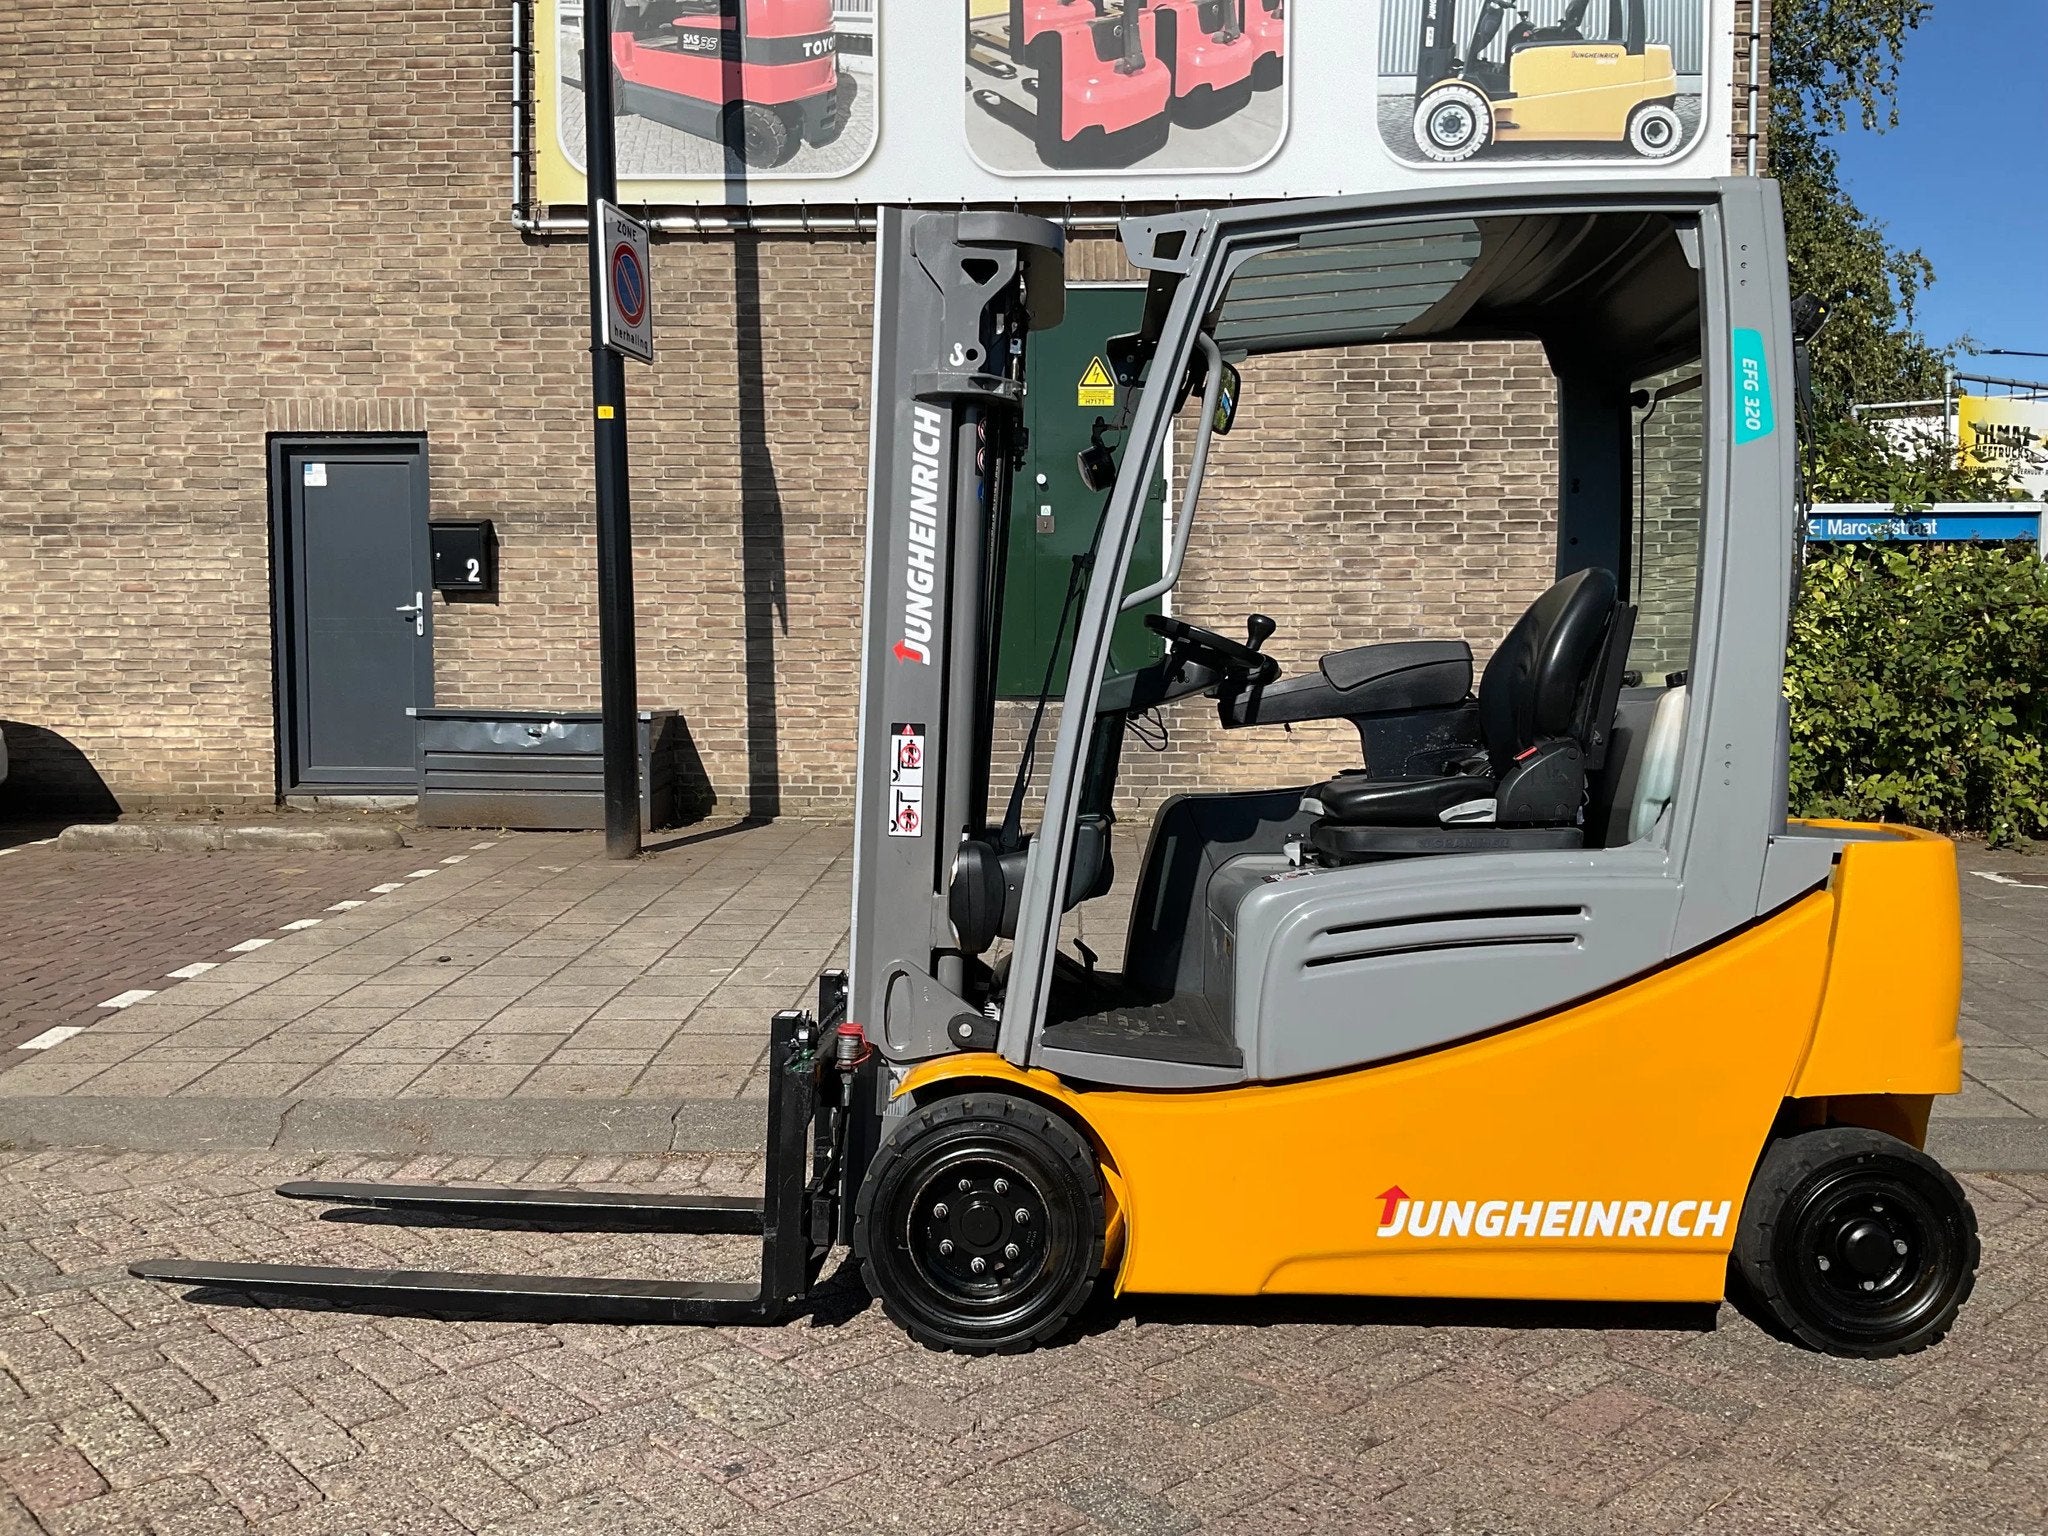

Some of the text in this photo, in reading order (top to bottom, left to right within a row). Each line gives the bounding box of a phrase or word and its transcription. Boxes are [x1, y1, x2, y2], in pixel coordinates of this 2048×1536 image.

[683, 33, 700, 45] SAS
[616, 220, 637, 243] ZONE
[614, 324, 648, 353] herhaling
[1742, 357, 1761, 431] EFG 320
[904, 406, 942, 666] JUNGHEINRICH
[466, 558, 480, 582] 2
[1375, 1200, 1732, 1237] JUNGHEINRICH
